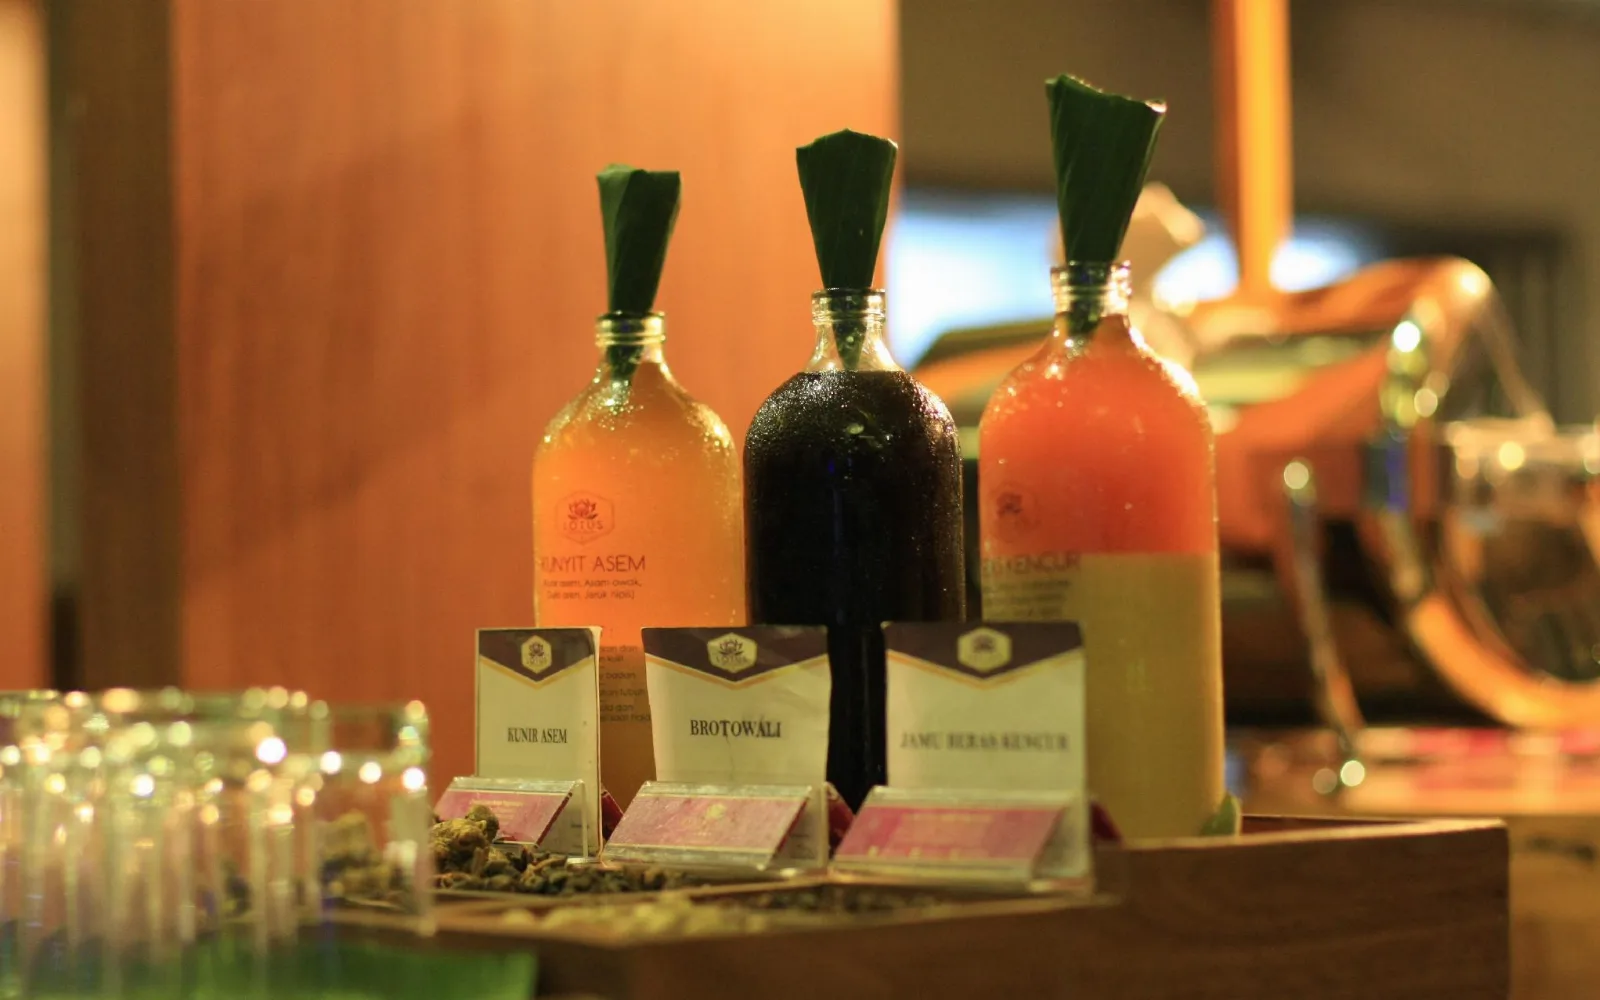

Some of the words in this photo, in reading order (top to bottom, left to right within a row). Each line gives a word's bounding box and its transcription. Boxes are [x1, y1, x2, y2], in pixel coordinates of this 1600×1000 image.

[563, 520, 604, 531] LOTUS
[593, 554, 646, 573] ASEM
[507, 727, 538, 743] KUNIR
[541, 728, 567, 744] ASEM
[690, 719, 782, 738] BROTOWALI
[900, 732, 941, 749] JAMU
[947, 732, 997, 749] BERAS
